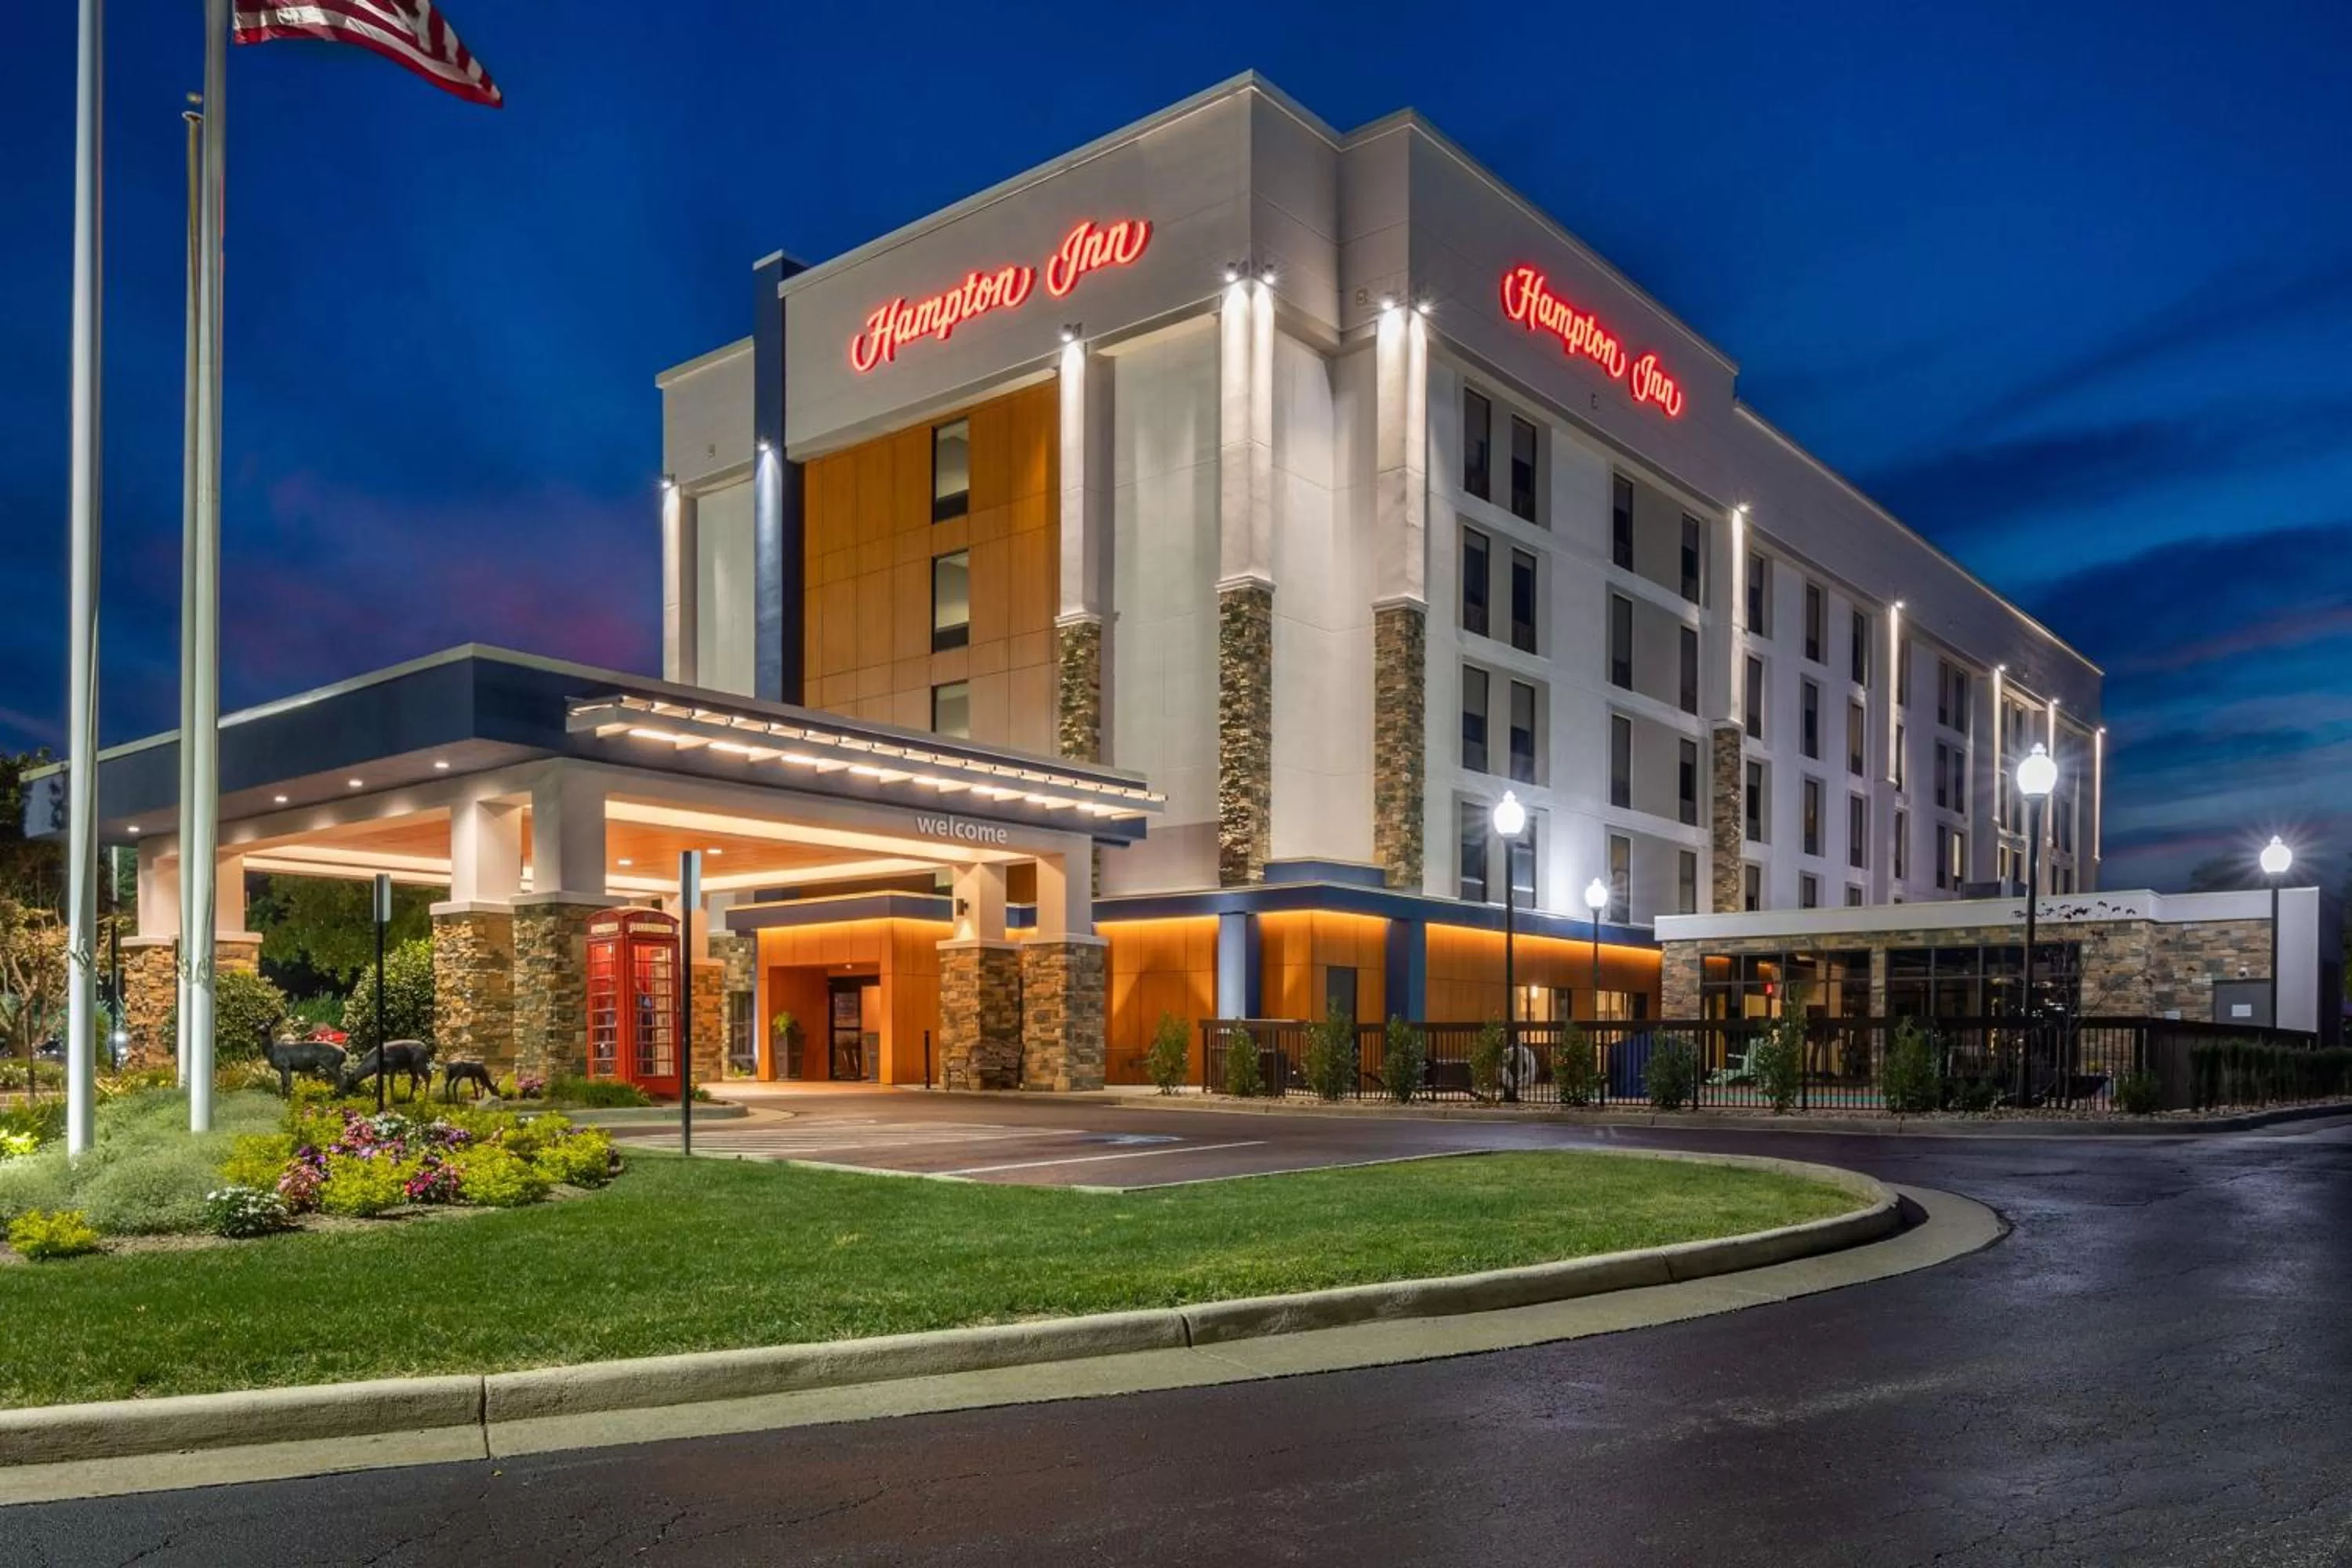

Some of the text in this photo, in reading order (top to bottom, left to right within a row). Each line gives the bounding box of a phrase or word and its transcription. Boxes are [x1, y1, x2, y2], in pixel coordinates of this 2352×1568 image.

[852, 220, 1152, 372] Hampton Inn
[1501, 267, 1682, 416] Hampton Inn
[916, 815, 1008, 844] welcome
